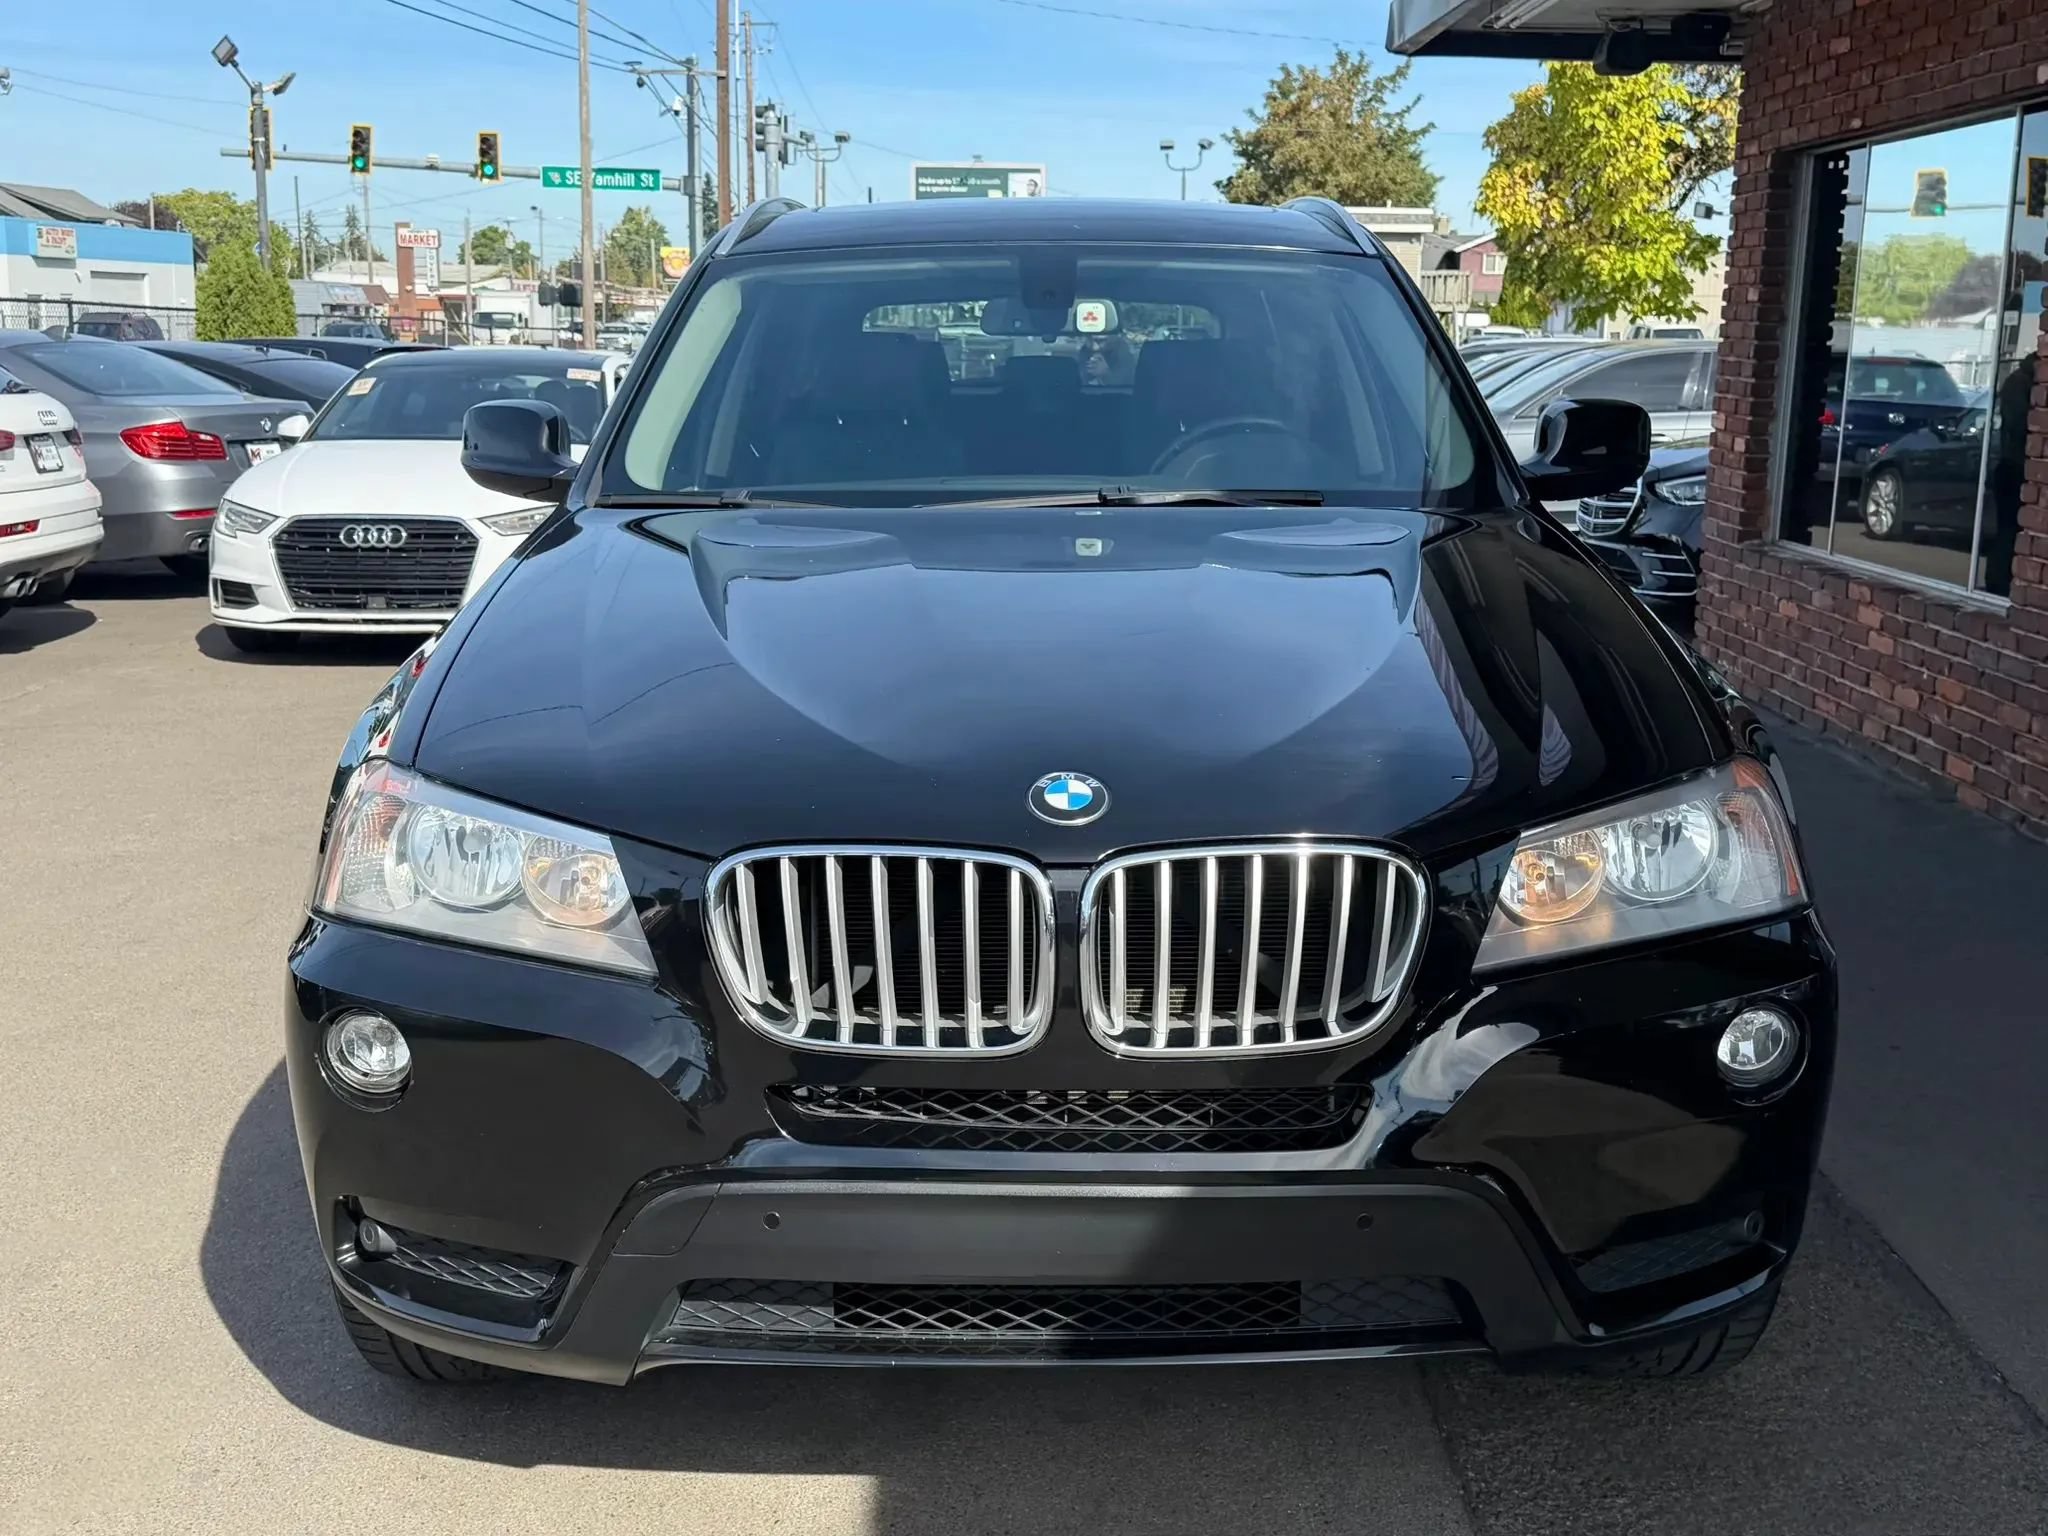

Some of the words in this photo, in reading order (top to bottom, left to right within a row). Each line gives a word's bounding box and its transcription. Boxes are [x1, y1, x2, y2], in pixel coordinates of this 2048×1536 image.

[565, 170, 582, 185] SE
[640, 172, 655, 188] St
[400, 233, 438, 246] MARKET
